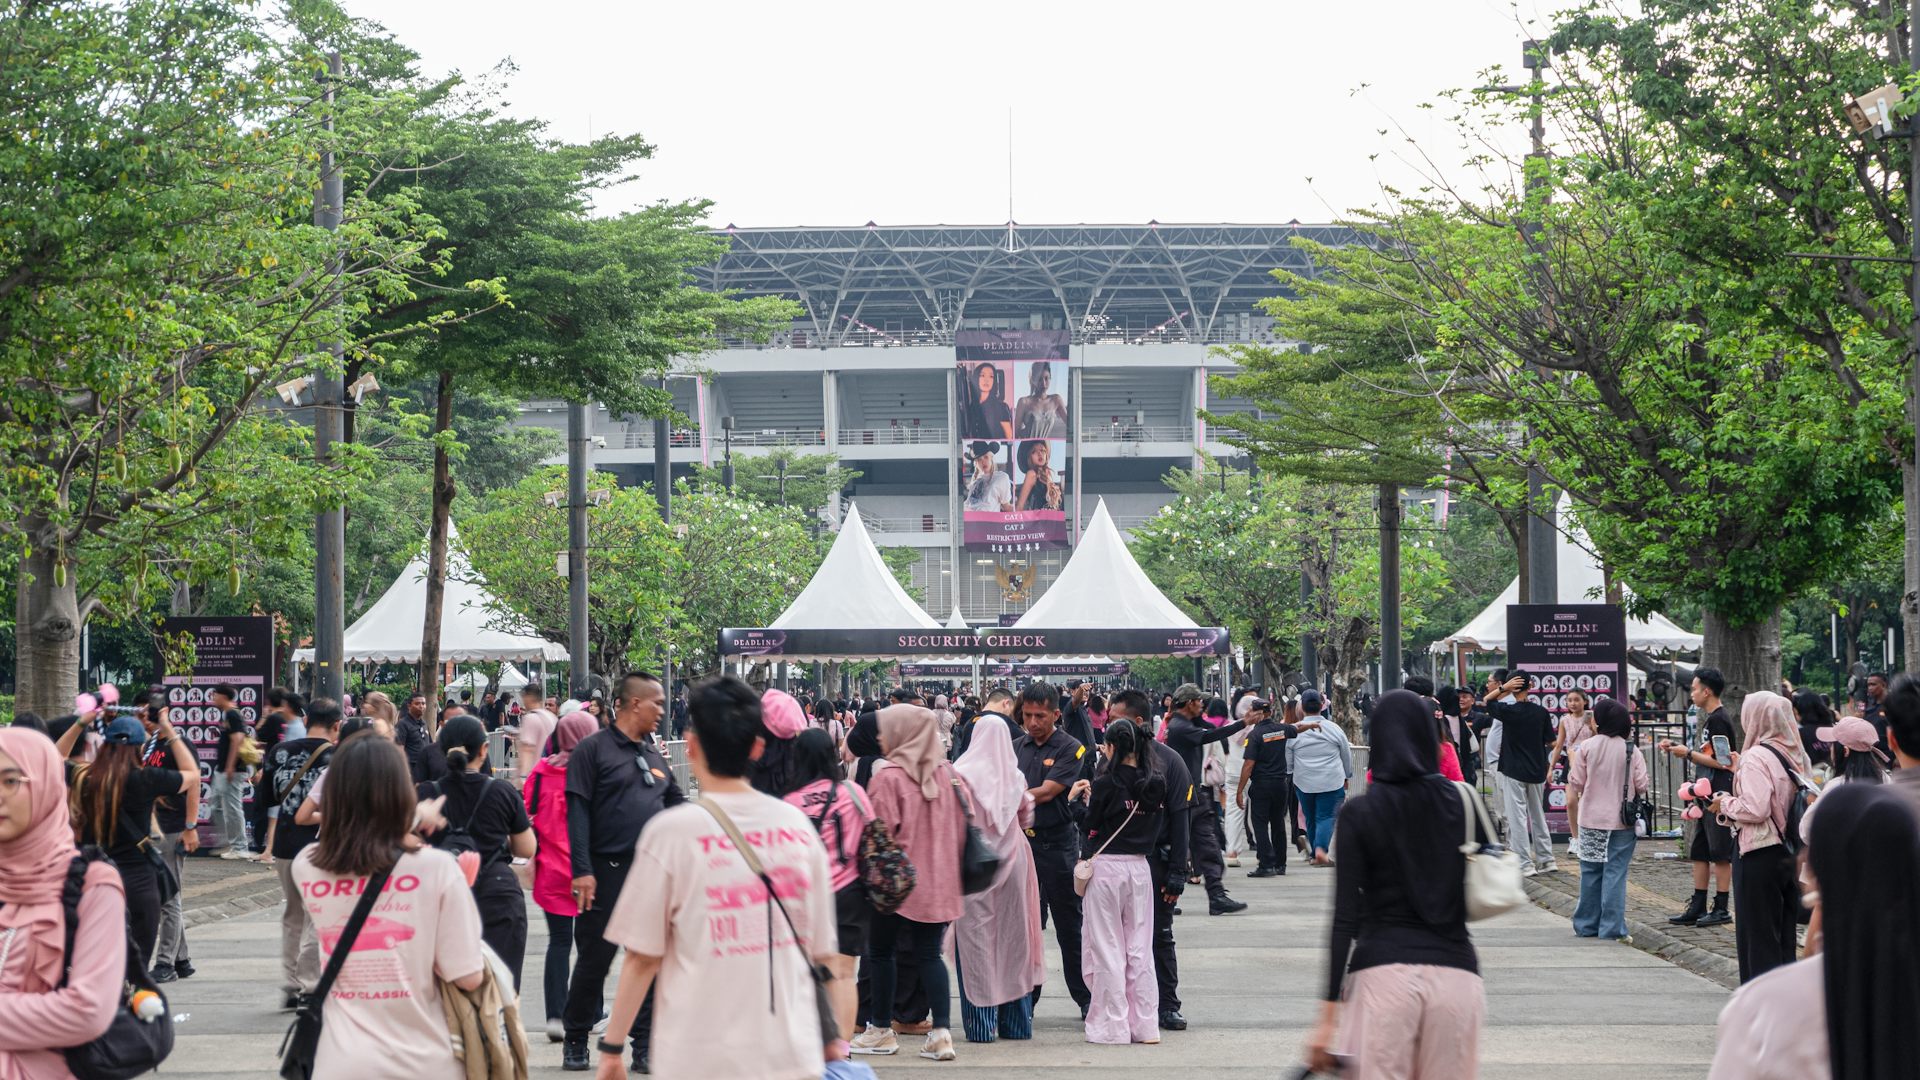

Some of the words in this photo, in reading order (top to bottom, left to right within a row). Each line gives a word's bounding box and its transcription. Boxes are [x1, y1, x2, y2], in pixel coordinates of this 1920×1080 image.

[983, 342, 1041, 350] DEADLINE
[986, 534, 1026, 542] RESTRICTED
[1027, 532, 1046, 540] VIEW
[1533, 623, 1599, 633] DEADLINE
[898, 635, 983, 648] SECURITY
[986, 635, 1046, 647] CHECK
[1167, 638, 1212, 646] DEADLINE
